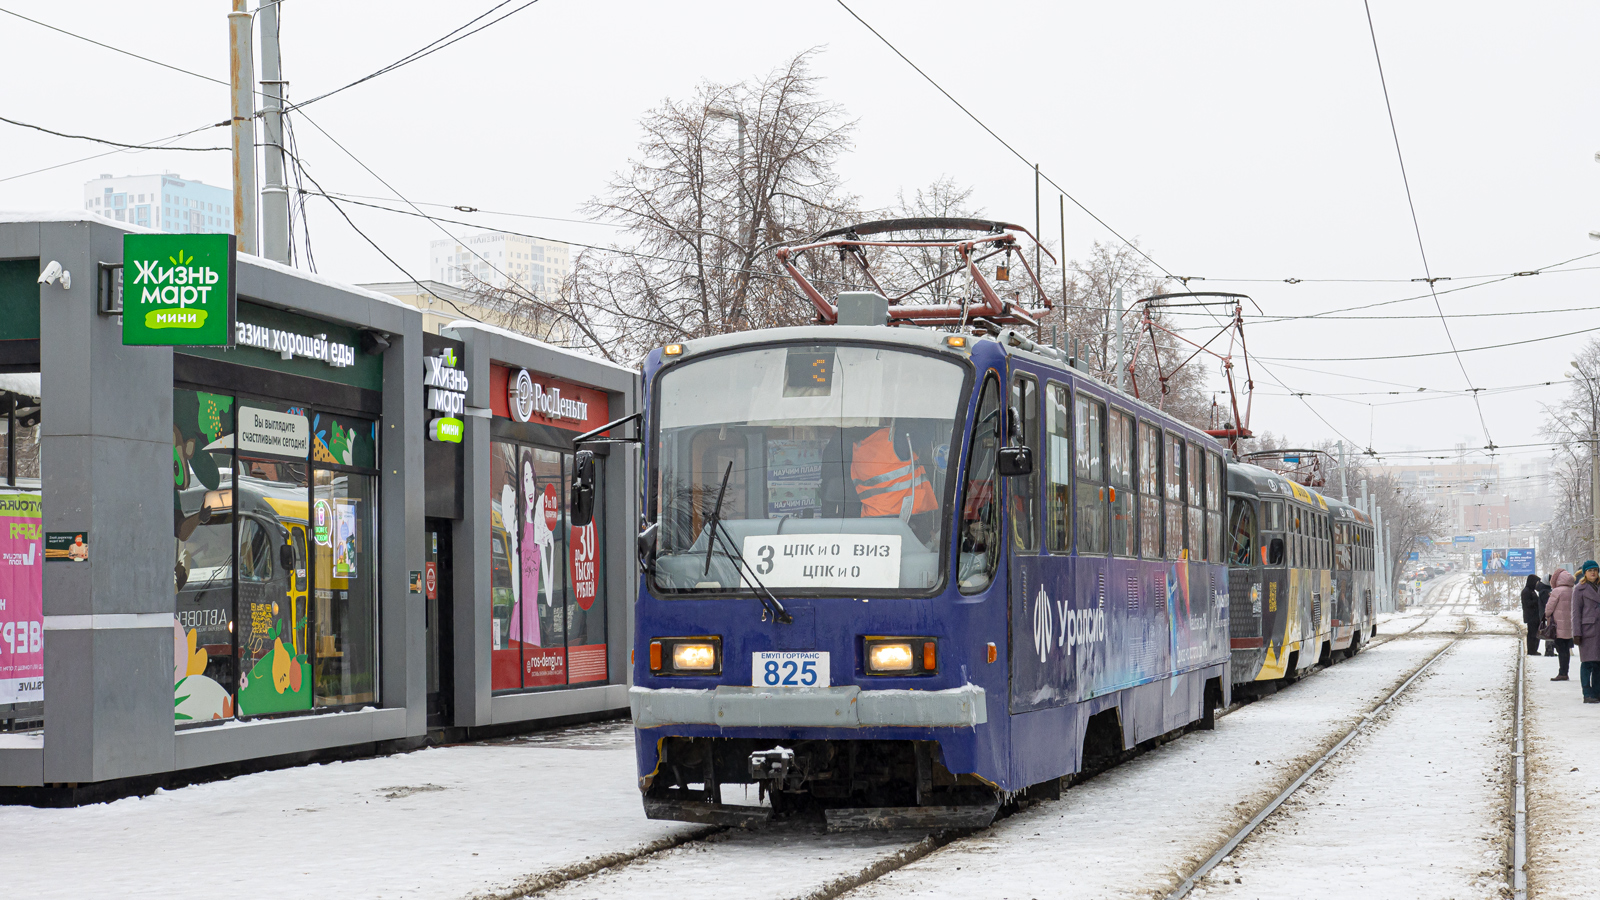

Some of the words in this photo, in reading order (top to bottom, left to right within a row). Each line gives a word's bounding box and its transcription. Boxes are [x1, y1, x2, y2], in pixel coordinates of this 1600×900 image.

[133, 260, 219, 285] Жизнь
[140, 285, 212, 308] март
[236, 322, 269, 348] азин
[273, 330, 328, 361] хорошей
[331, 342, 354, 367] еды
[430, 356, 468, 391] Жизнь
[535, 383, 588, 421] РосДеньги
[254, 414, 264, 428] Вы
[264, 418, 296, 433] выглядите
[242, 431, 282, 446] счастливыми
[282, 437, 307, 450] сегодня!
[773, 467, 800, 477] НАУЧИМ
[756, 545, 775, 575] 3
[783, 544, 815, 557] ЦПК
[818, 545, 827, 556] и
[853, 544, 890, 557] ВИЗ
[576, 561, 594, 581] ТЫСЯЧ
[802, 565, 834, 578] ЦПК
[838, 566, 847, 577] и
[576, 578, 595, 599] РУБЛЕЙ
[1057, 600, 1105, 655] Уралсиб
[531, 652, 563, 671] ros-dengi.ru
[763, 661, 818, 686] 825
